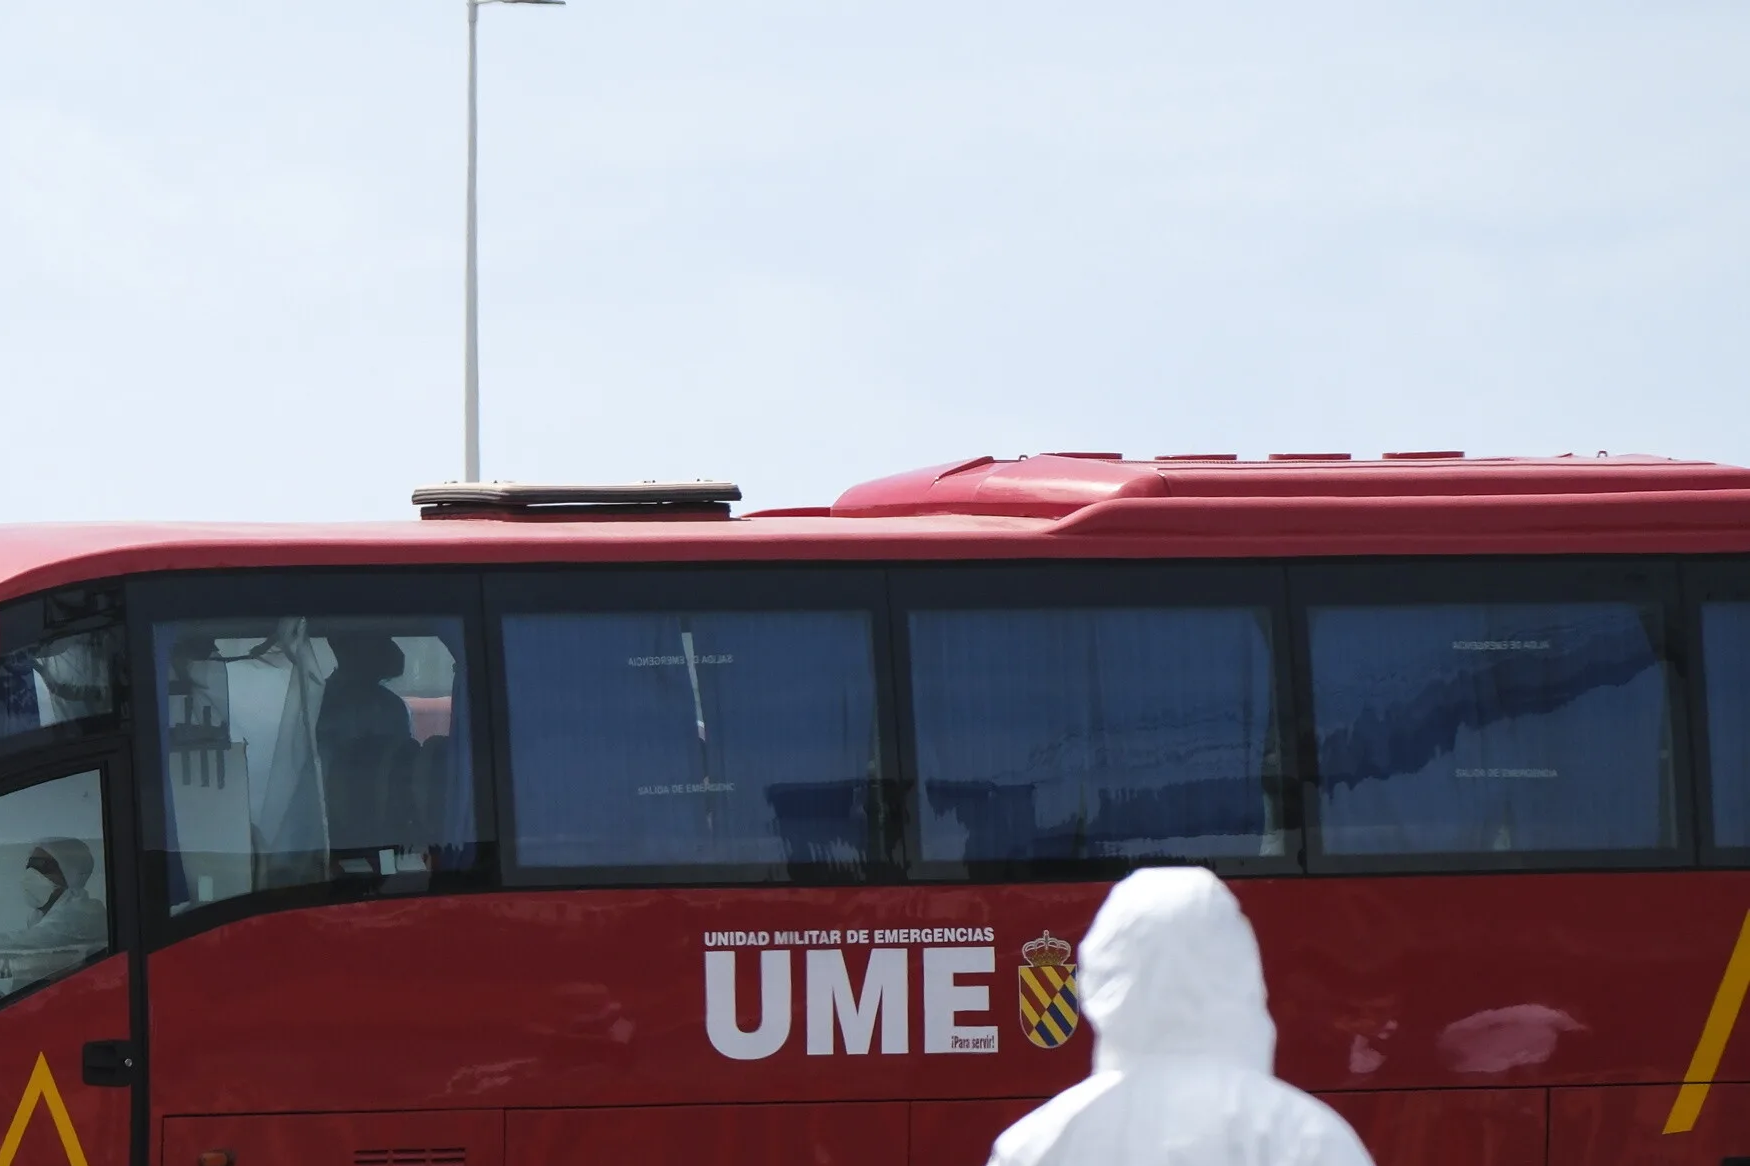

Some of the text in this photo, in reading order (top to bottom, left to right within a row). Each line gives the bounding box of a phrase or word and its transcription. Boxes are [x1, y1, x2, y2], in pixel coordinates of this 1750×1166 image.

[638, 785, 669, 795] SALIDA
[672, 784, 684, 794] DE
[704, 927, 995, 947] UNIDAD MILITAR DE EMERGENCIAS
[704, 946, 999, 1061] UME
[971, 1034, 995, 1050] servir!
